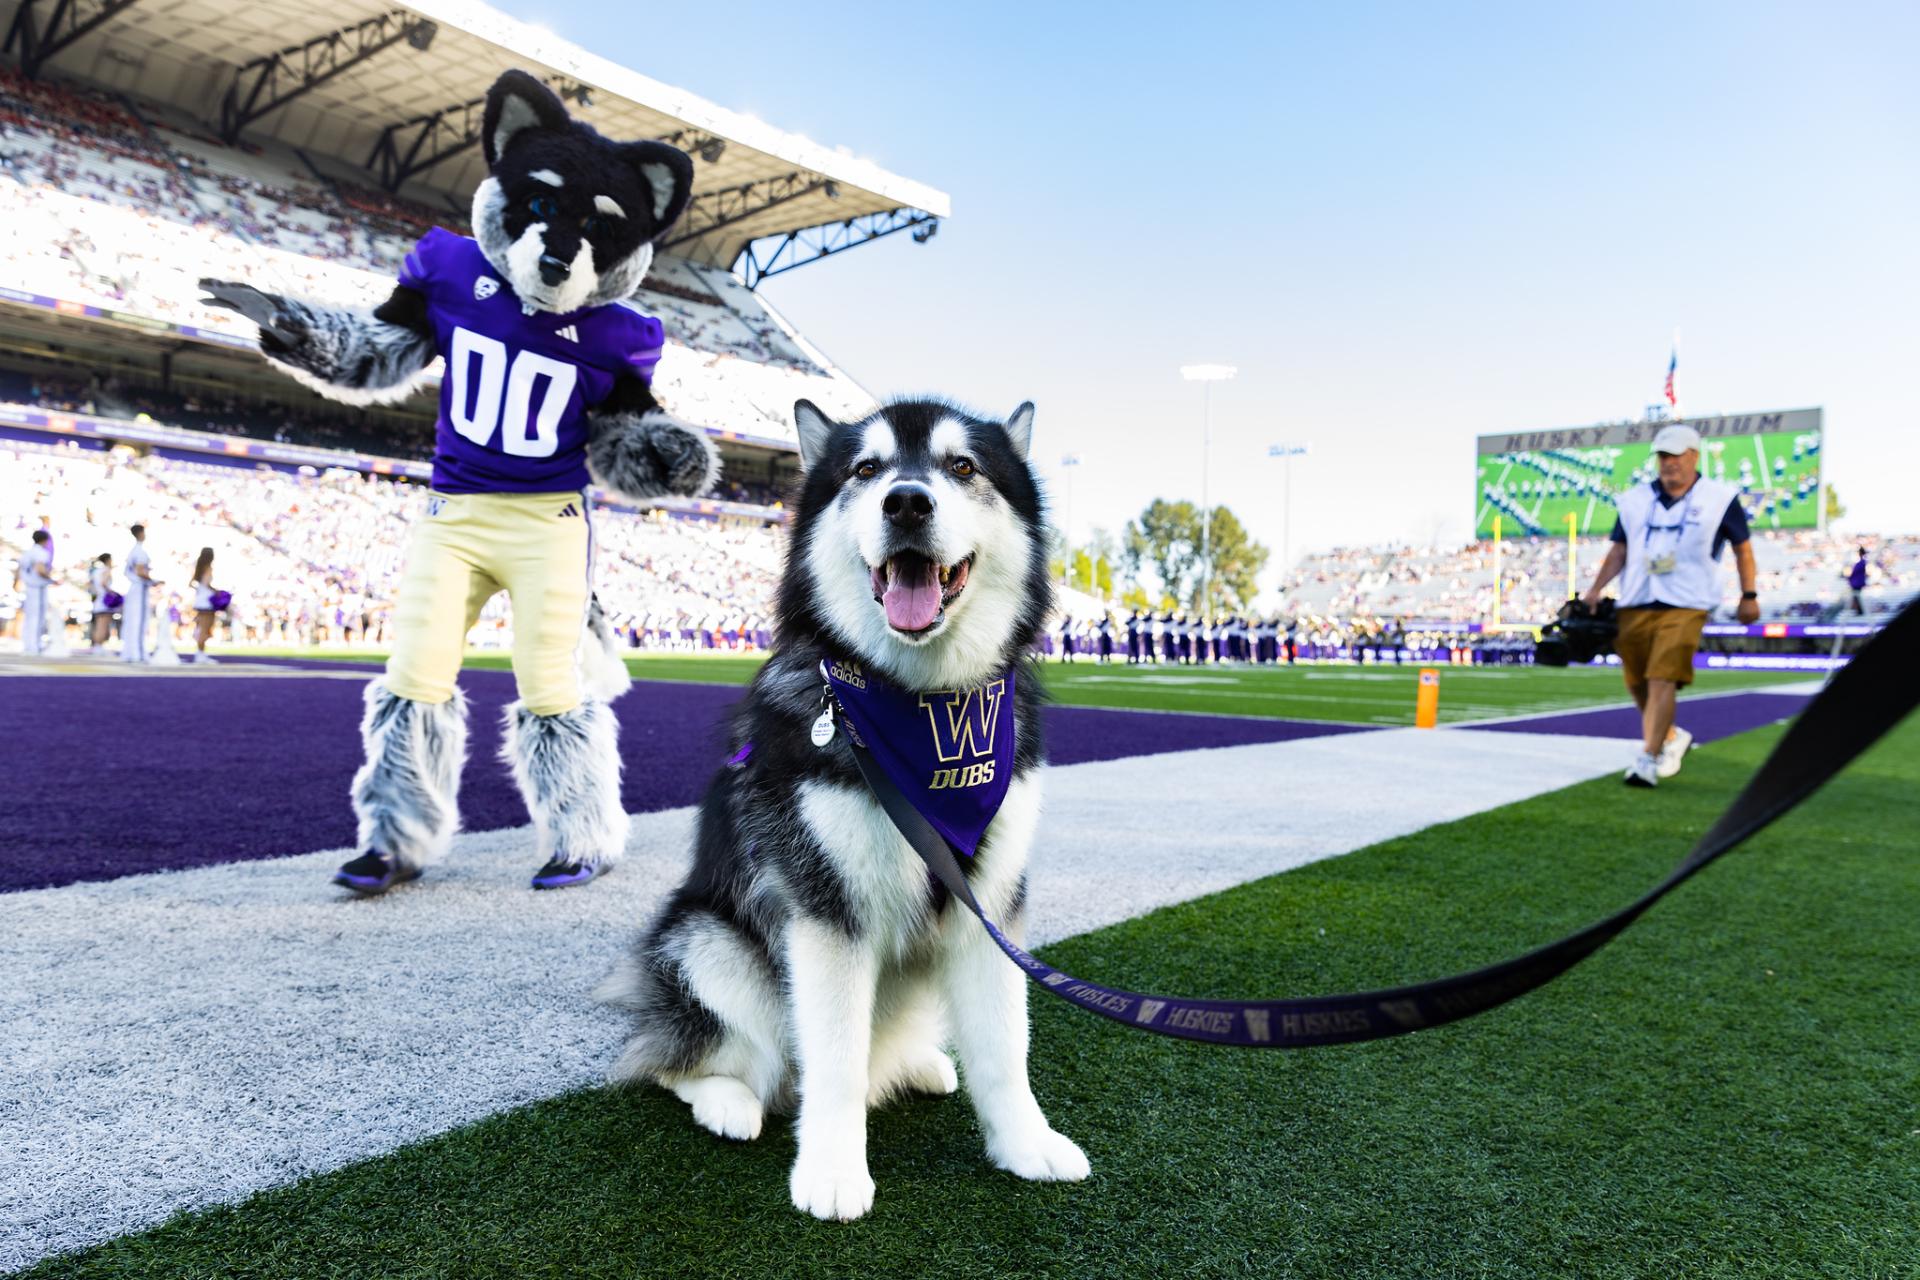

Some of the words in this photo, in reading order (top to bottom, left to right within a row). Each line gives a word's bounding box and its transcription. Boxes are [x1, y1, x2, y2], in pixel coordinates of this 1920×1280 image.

[450, 326, 577, 458] 00
[1505, 429, 1608, 450] HUSKY
[1625, 414, 1784, 443] STDIUM
[831, 666, 866, 689] adidas
[919, 679, 1005, 762] W
[928, 760, 995, 789] DUBS
[1066, 984, 1131, 1013] HUSKIES
[1164, 1006, 1235, 1033] HUSKIES
[1282, 1009, 1371, 1037] HUSKIES
